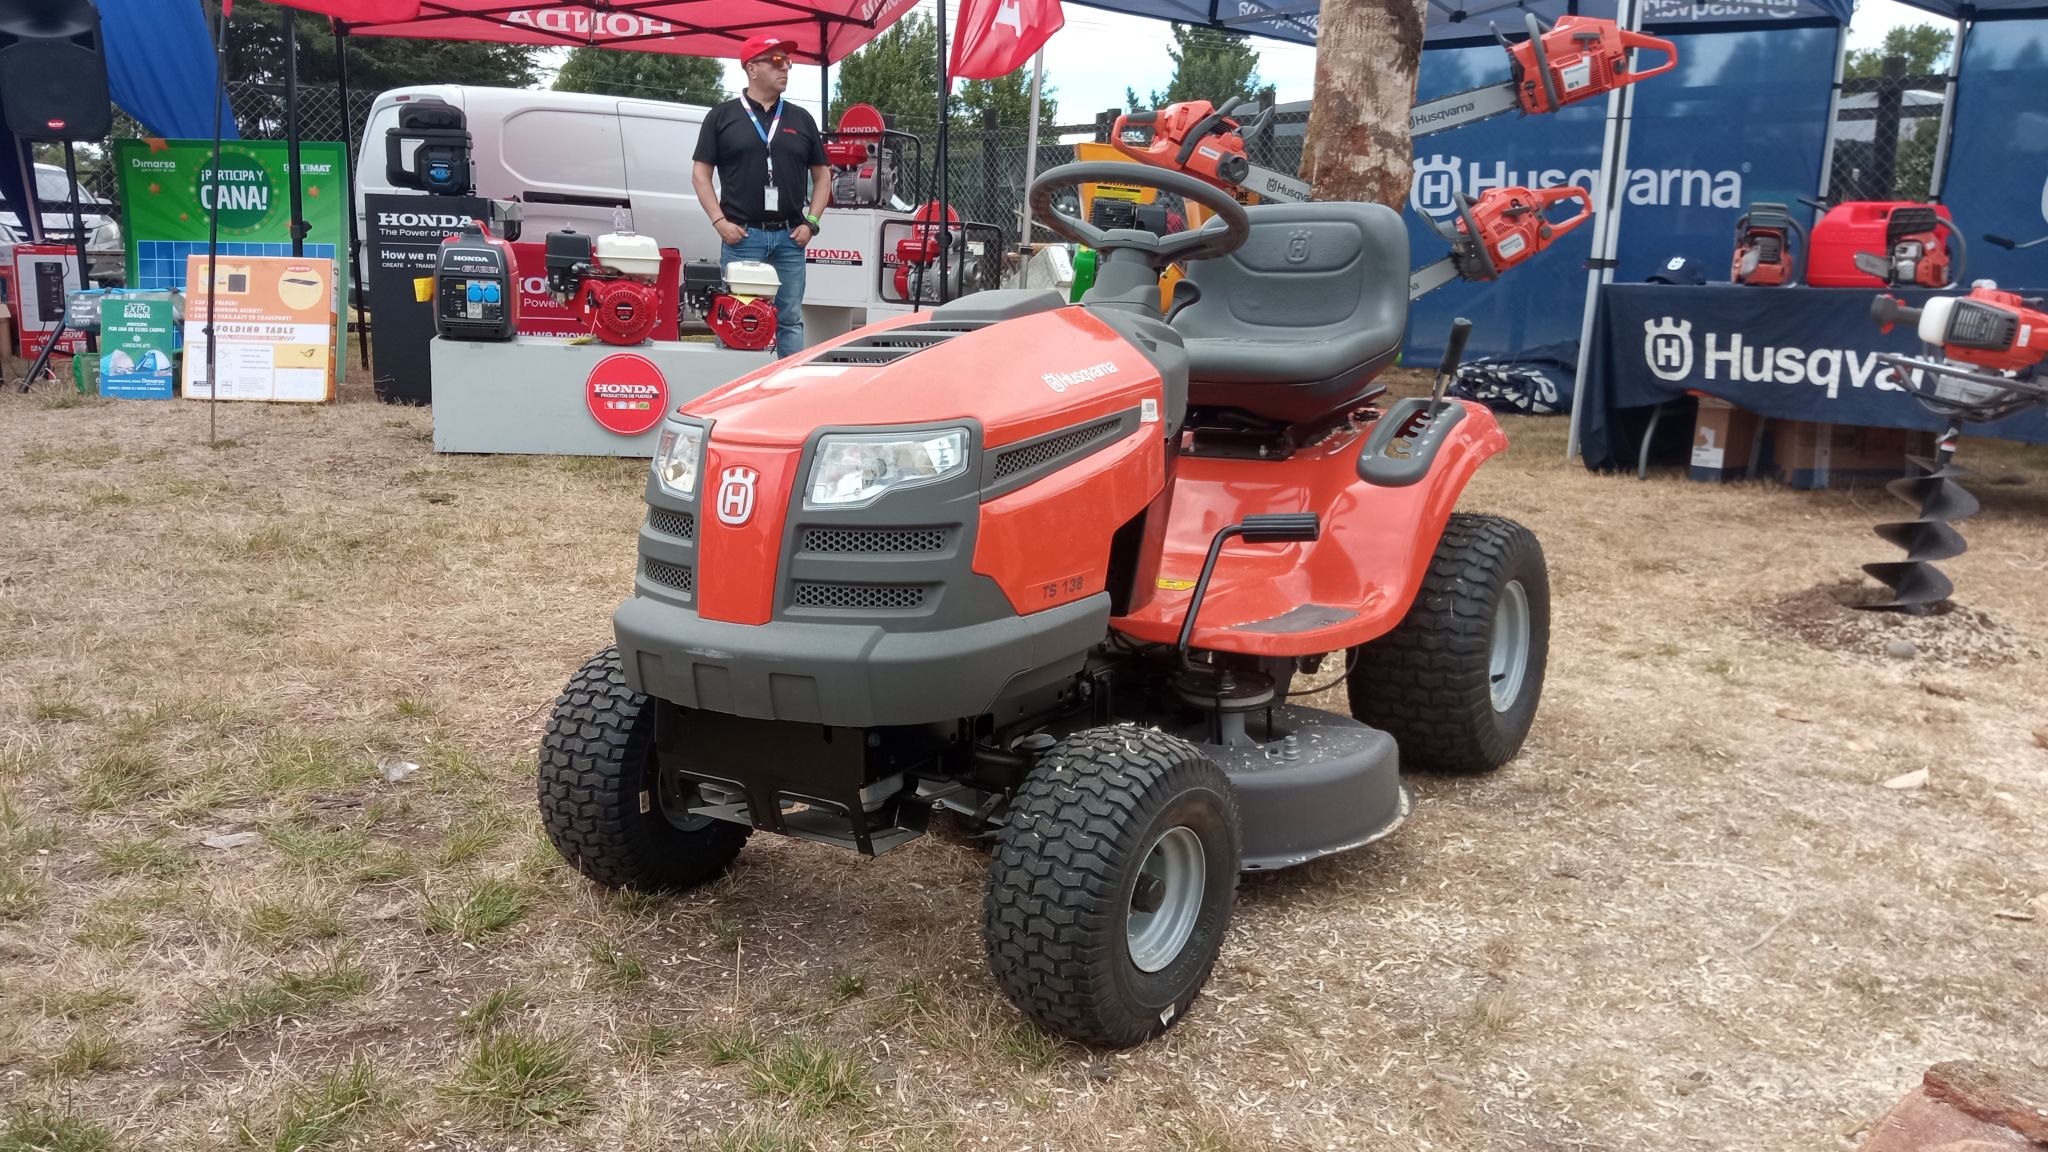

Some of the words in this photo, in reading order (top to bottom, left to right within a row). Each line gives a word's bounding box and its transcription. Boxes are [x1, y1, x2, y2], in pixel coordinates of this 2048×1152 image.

[1416, 102, 1475, 126] Husqvarna
[201, 169, 255, 182] ¡PRTICIPA
[378, 213, 476, 228] HONDA
[379, 228, 398, 236] The
[400, 229, 429, 237] Power
[381, 250, 406, 260] How
[408, 252, 424, 260] we
[806, 248, 862, 259] HONDA
[124, 305, 151, 314] EXPO
[265, 326, 295, 334] TABLE
[1060, 361, 1119, 387] Husqvarna
[594, 384, 659, 393] HONDA
[1042, 583, 1057, 600] TS
[1062, 577, 1084, 595] 138
